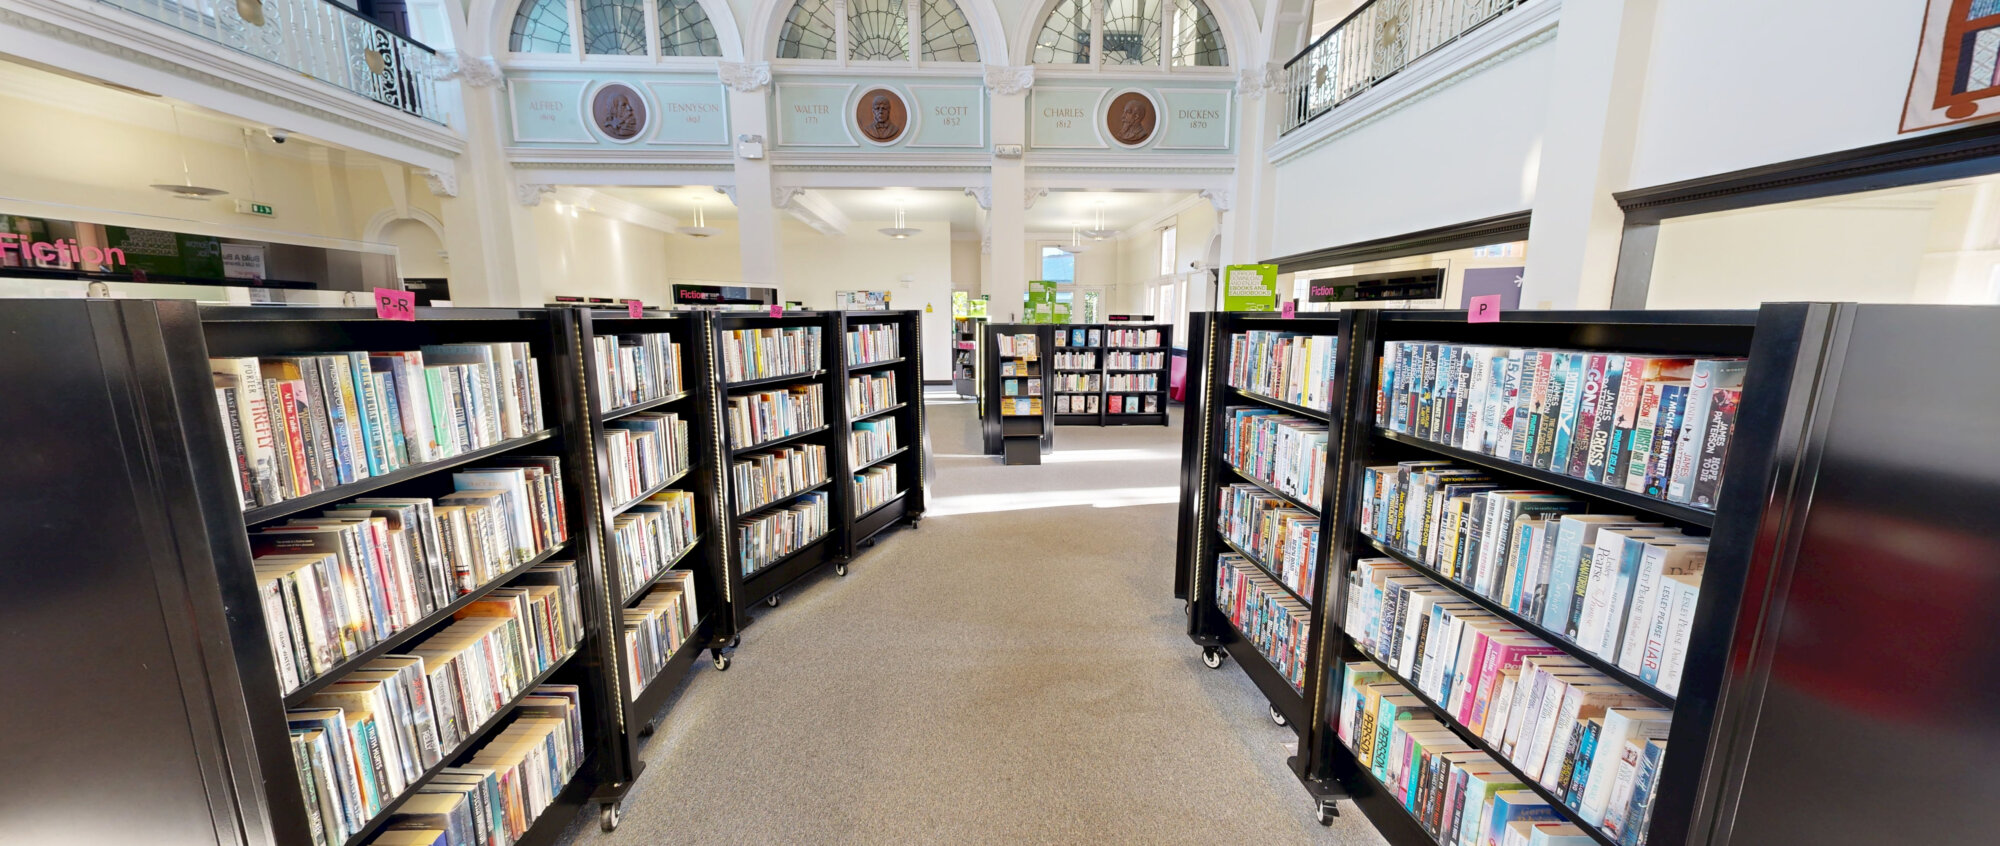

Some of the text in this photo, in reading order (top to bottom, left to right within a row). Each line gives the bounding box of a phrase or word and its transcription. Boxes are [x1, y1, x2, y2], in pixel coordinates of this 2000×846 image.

[530, 101, 562, 110] ALFRED
[667, 102, 720, 112] TENNYSON
[794, 104, 830, 114] WALTER
[934, 106, 968, 116] SCOTT
[1043, 108, 1084, 118] CHARLES
[1178, 109, 1220, 120] DICKENS
[1056, 120, 1072, 129] 1812
[1190, 120, 1208, 130] 1870
[0, 232, 127, 266] Fiction
[381, 296, 408, 312] P-R
[1311, 285, 1334, 296] Fiction
[1480, 304, 1488, 316] P
[244, 363, 257, 393] PORTER
[1423, 351, 1431, 388] PATTERSON
[1447, 350, 1456, 388] PATTERSON
[1516, 359, 1538, 408] PATTERSON
[1537, 366, 1548, 395] JAMES
[358, 358, 367, 369] WE
[367, 402, 378, 419] LIKE
[1456, 372, 1469, 408] Patterson
[1542, 371, 1556, 413] PATTERSON
[1550, 381, 1562, 406] JAMES
[1560, 370, 1580, 415] PATTERSON
[1578, 368, 1600, 416] GONE
[1622, 374, 1639, 408] JAMES
[1640, 383, 1655, 417] PATTERSON
[1651, 393, 1659, 409] JAMES
[270, 382, 283, 431] MAX PORTER
[285, 400, 294, 412] The
[1600, 389, 1616, 422] JAMES
[1658, 400, 1681, 439] MICHAEL
[250, 397, 273, 450] FIREFLY
[1525, 413, 1536, 453] PRIVATE VEGAS
[1536, 414, 1550, 454] ALEX CROSS
[1579, 424, 1591, 452] JAMES
[1702, 409, 1727, 454] PATTERSON
[1713, 420, 1731, 447] JAMES
[232, 427, 243, 452] FLYING
[1589, 429, 1608, 467] CROSS
[1606, 428, 1622, 474] PRIVATE DELHI
[1633, 427, 1652, 452] ROSES
[1652, 438, 1675, 477] BENNETT
[1678, 452, 1693, 478] JAMES
[1697, 457, 1712, 482] TO DIE
[1705, 455, 1722, 481] HOPE
[1421, 514, 1431, 546] PARSONS
[1458, 516, 1468, 534] ICE
[1551, 527, 1576, 578] PEARSE
[1590, 546, 1610, 582] Pearse
[1602, 555, 1615, 578] Lesley
[1573, 557, 1592, 596] SANATORIUM
[1640, 554, 1656, 584] LESLEY
[1634, 583, 1650, 614] PEARSE
[1678, 590, 1694, 617] LESLEY
[1416, 618, 1428, 660] LOUISE PENNY
[1600, 628, 1612, 648] AGAIN
[1644, 585, 1670, 670] LESLEY PEARSE LIAR
[1674, 618, 1688, 646] PEARSE
[1486, 650, 1498, 672] Louise
[367, 725, 382, 770] TRUTH HURTS
[421, 730, 432, 750] REILLY
[1359, 712, 1373, 758] PERSSON
[1374, 725, 1388, 772] PERSSON
[1582, 725, 1598, 760] KAREN PERRY
[1574, 782, 1585, 803] CLOSEST
